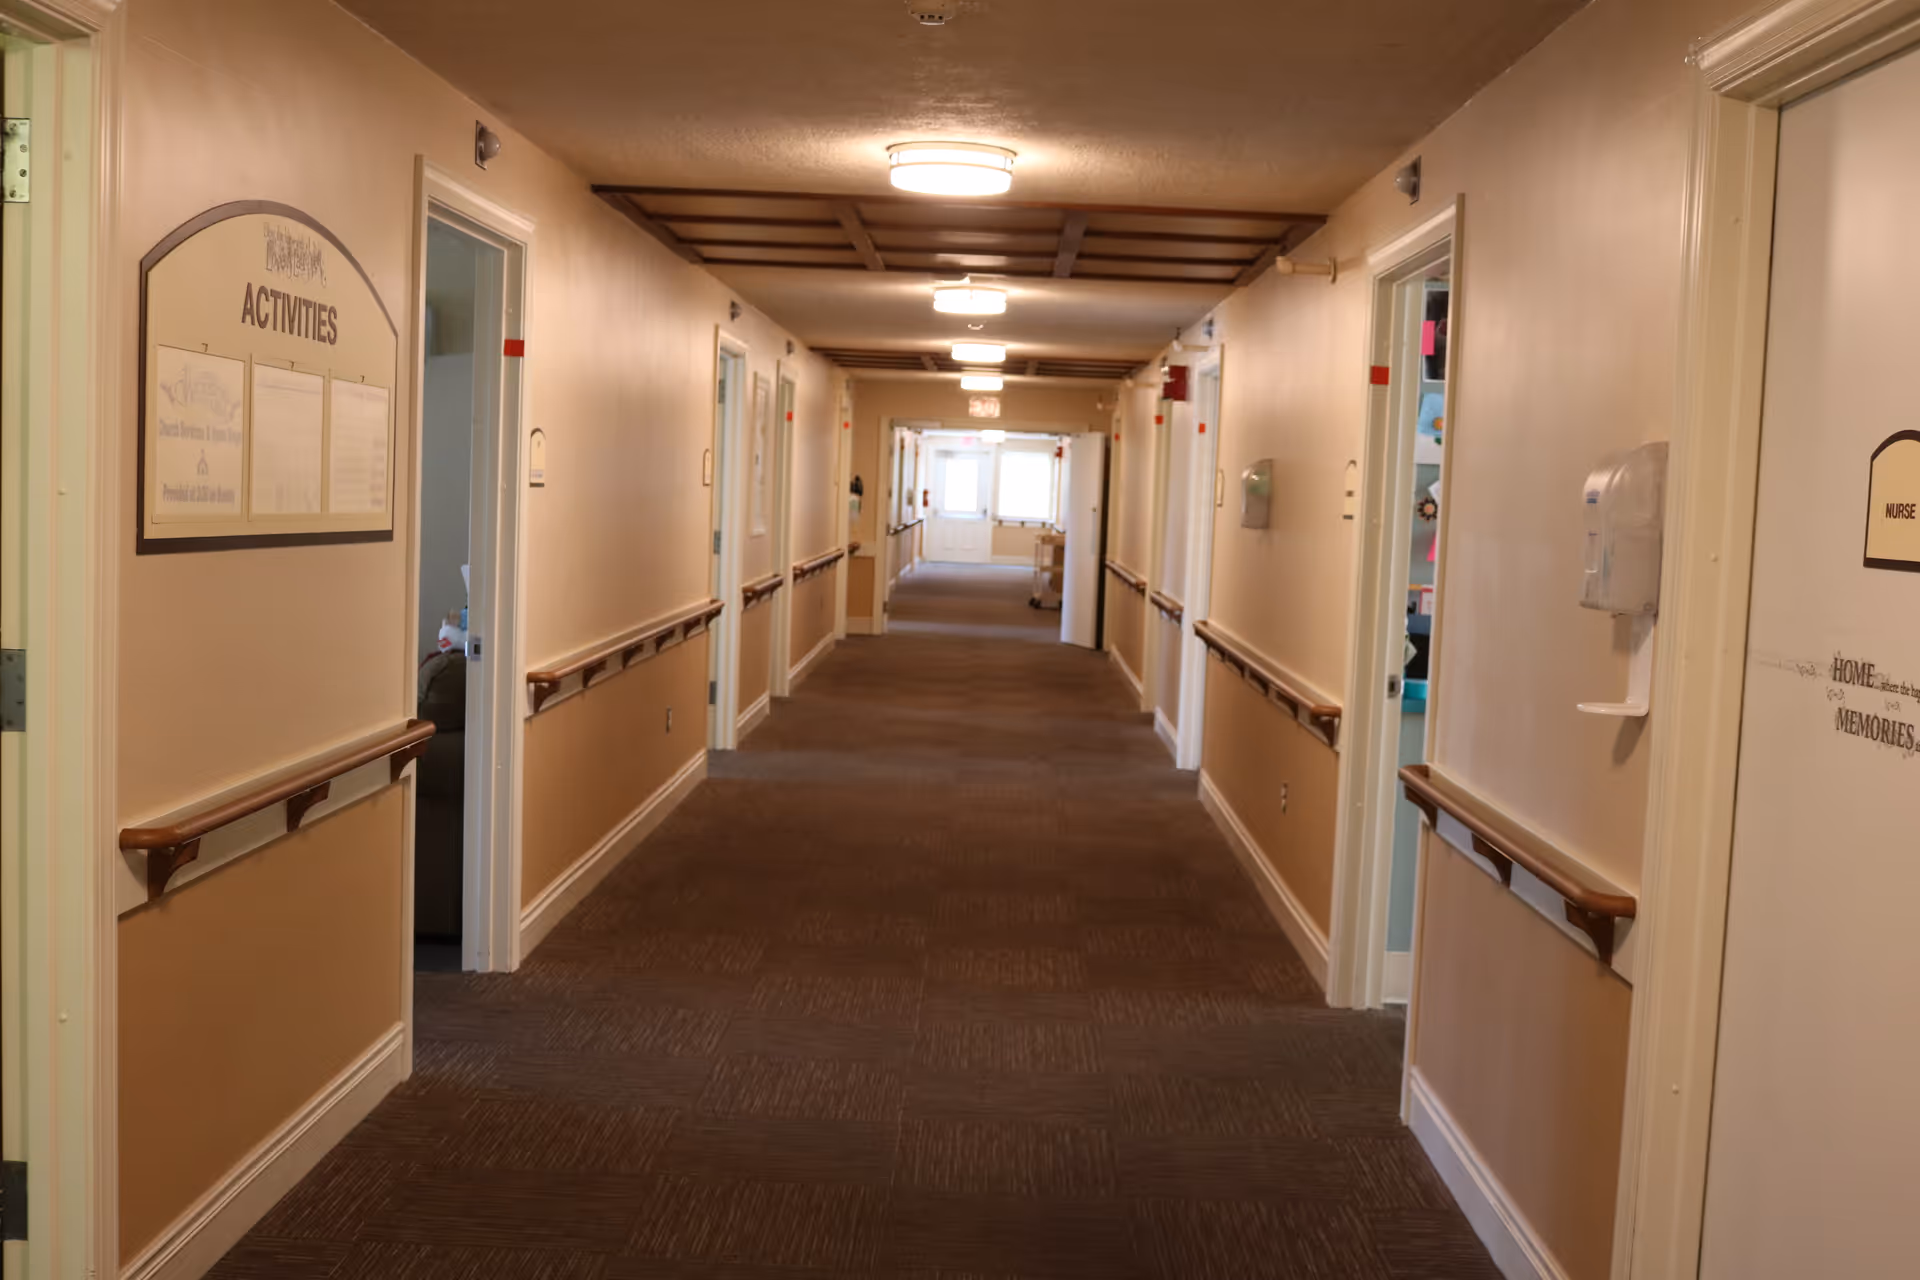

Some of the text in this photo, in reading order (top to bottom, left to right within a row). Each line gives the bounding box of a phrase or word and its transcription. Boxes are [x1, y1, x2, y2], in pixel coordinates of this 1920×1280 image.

[241, 282, 338, 346] ACTIVITIES
[1885, 503, 1916, 520] NURSE
[1900, 681, 1910, 696] the
[1836, 706, 1915, 750] MEMORIES
